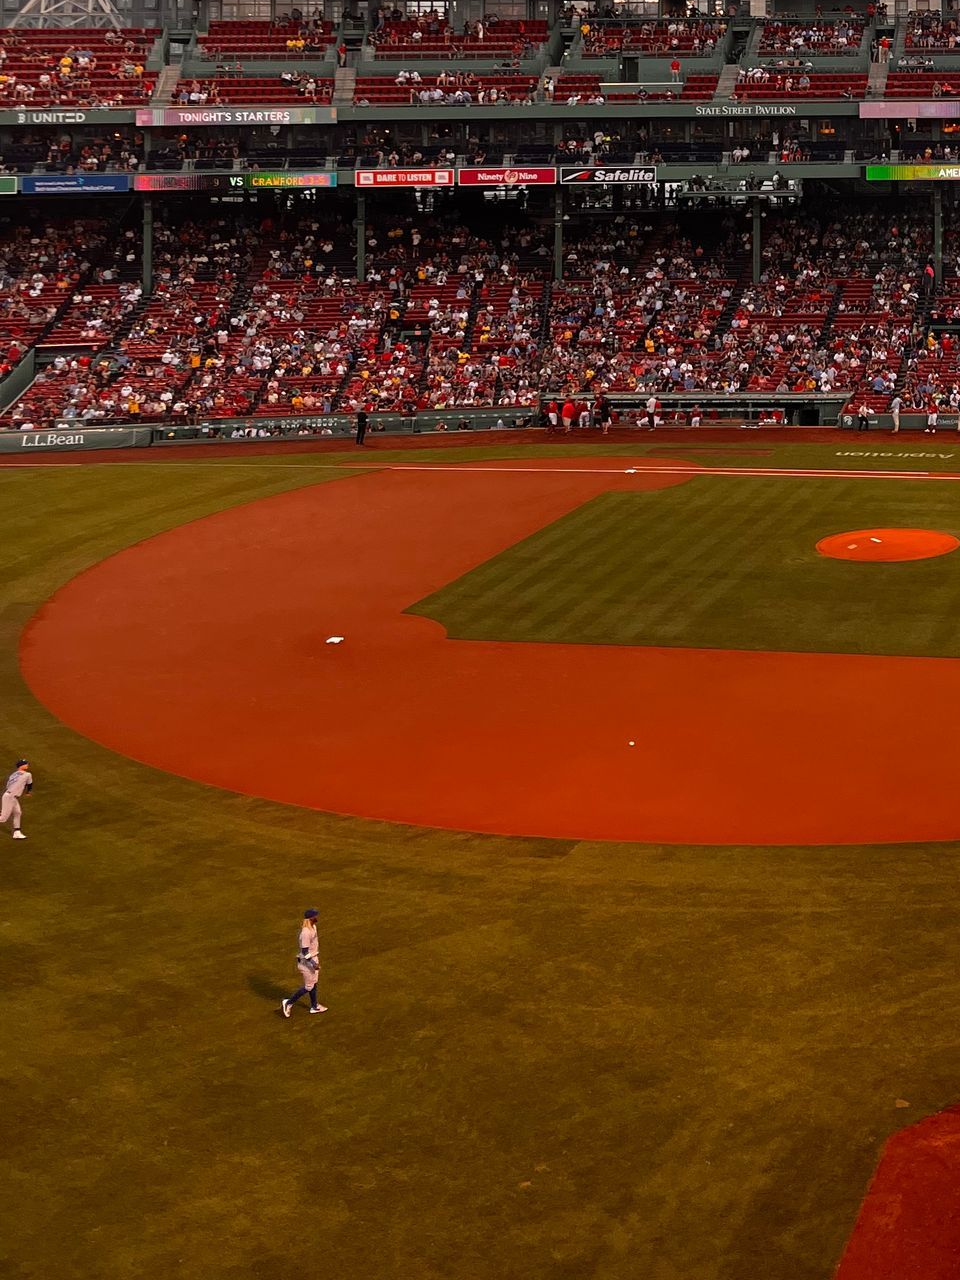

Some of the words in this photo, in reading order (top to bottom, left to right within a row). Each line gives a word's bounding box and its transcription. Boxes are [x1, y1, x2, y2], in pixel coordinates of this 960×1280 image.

[695, 106, 721, 115] STATE
[722, 106, 752, 115] STREET
[755, 106, 796, 115] PAVILION
[33, 113, 86, 122] UNITED
[178, 112, 232, 122] TONIGHT'S
[235, 111, 290, 121] STARTERS
[376, 174, 397, 182] DARE
[477, 173, 504, 181] Ninety
[519, 172, 538, 180] Nine
[594, 170, 654, 181] Safelite
[229, 177, 244, 186] VS
[252, 177, 304, 186] CRAWFORD
[21, 434, 84, 447] L.L.Bean
[835, 451, 955, 459] Aspiration
